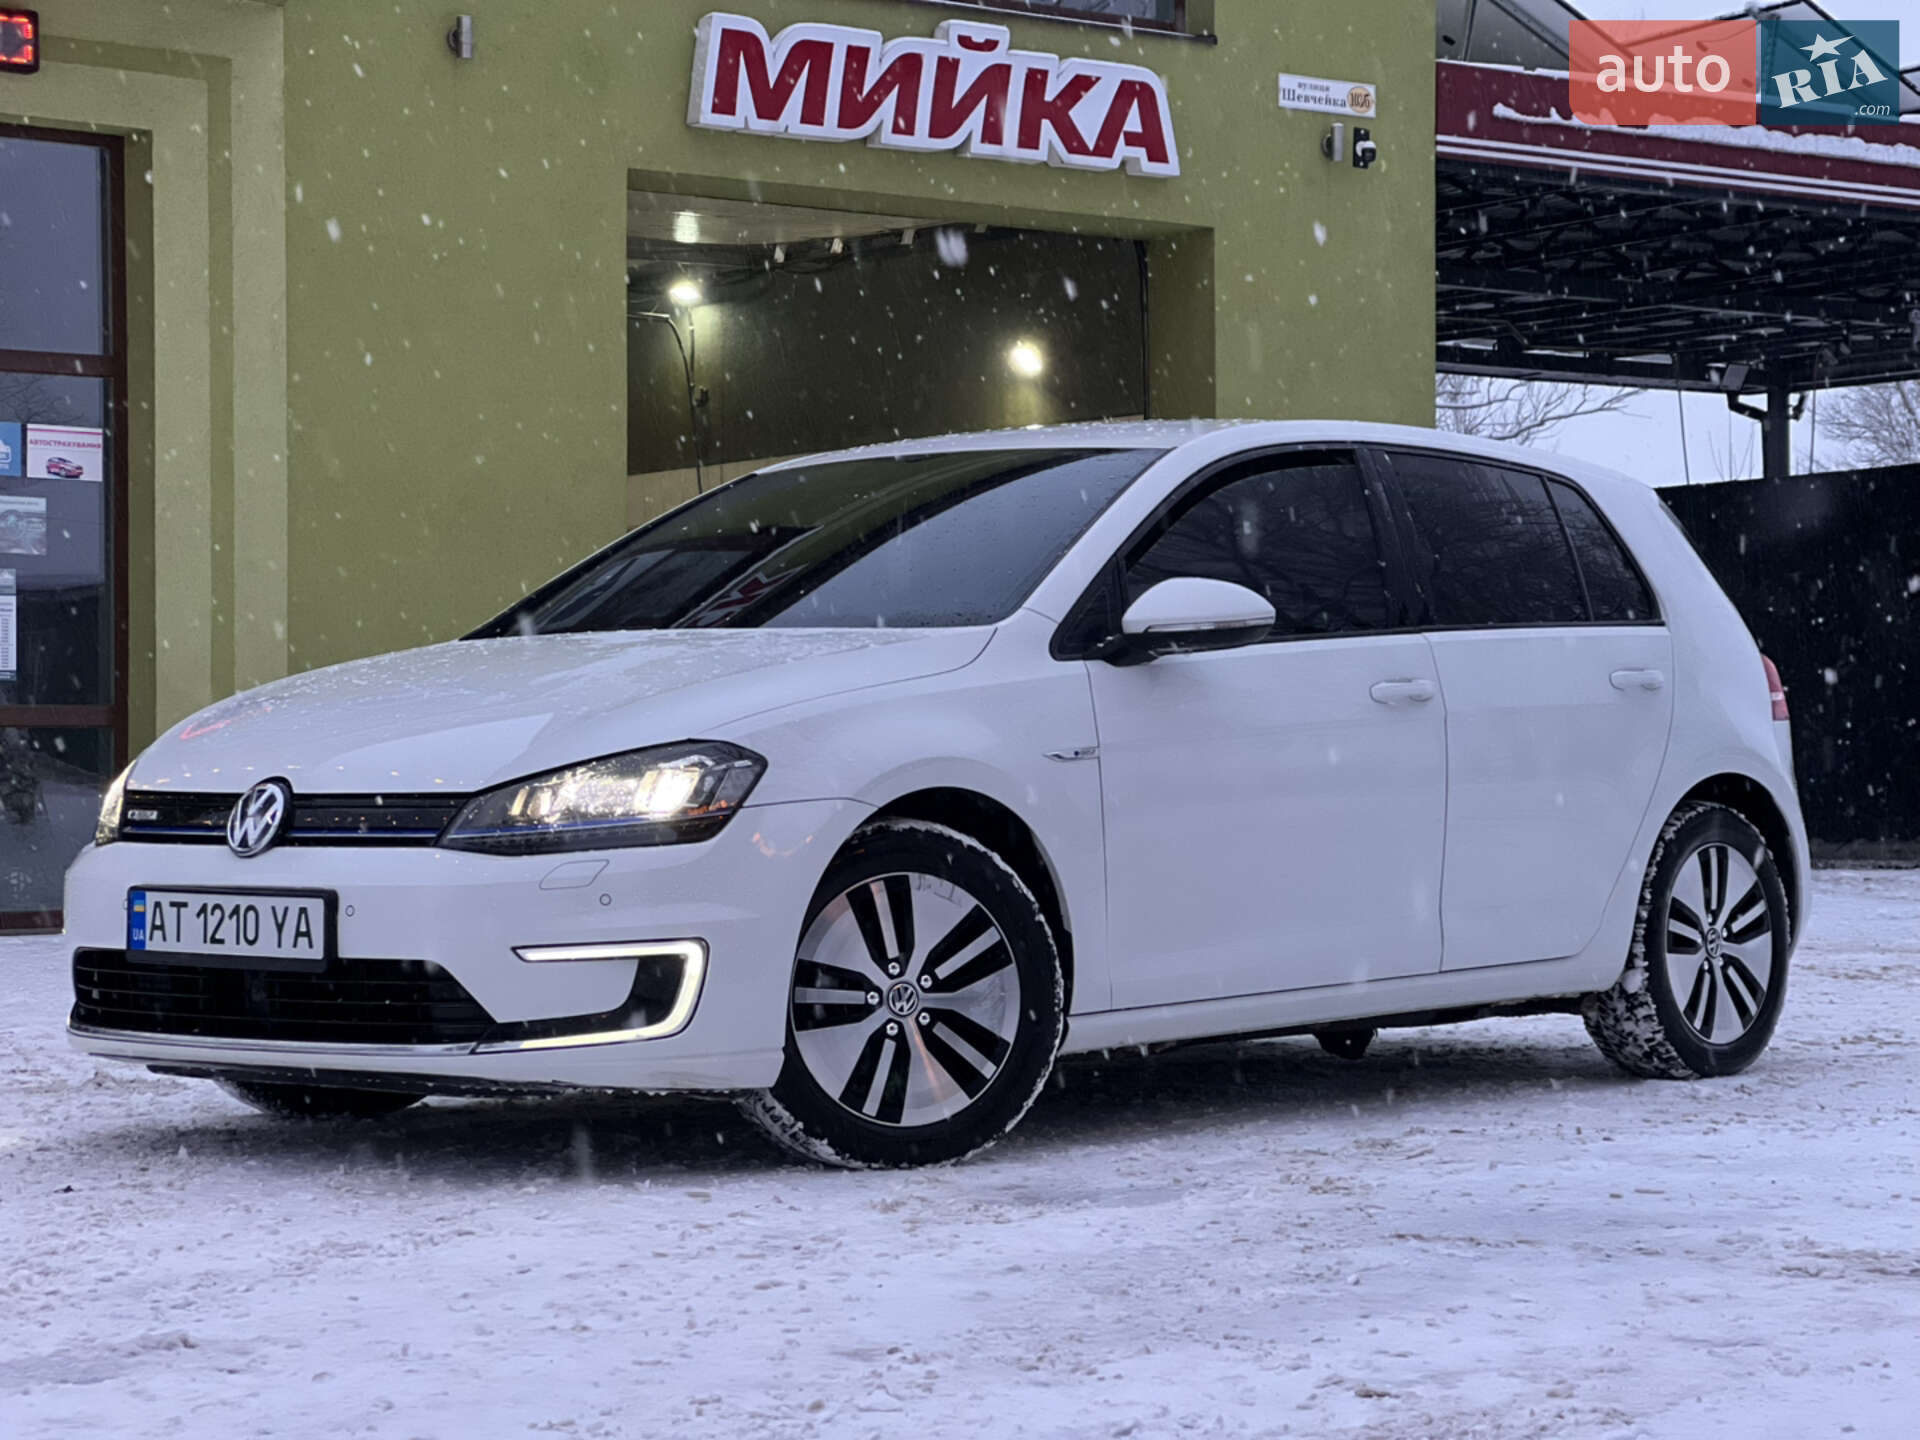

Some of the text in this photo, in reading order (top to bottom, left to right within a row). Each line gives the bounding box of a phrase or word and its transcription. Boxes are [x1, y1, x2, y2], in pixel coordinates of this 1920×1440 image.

[711, 28, 1169, 164] МИЙКА
[132, 927, 145, 941] UA
[149, 901, 314, 949] AT 1210 YA
